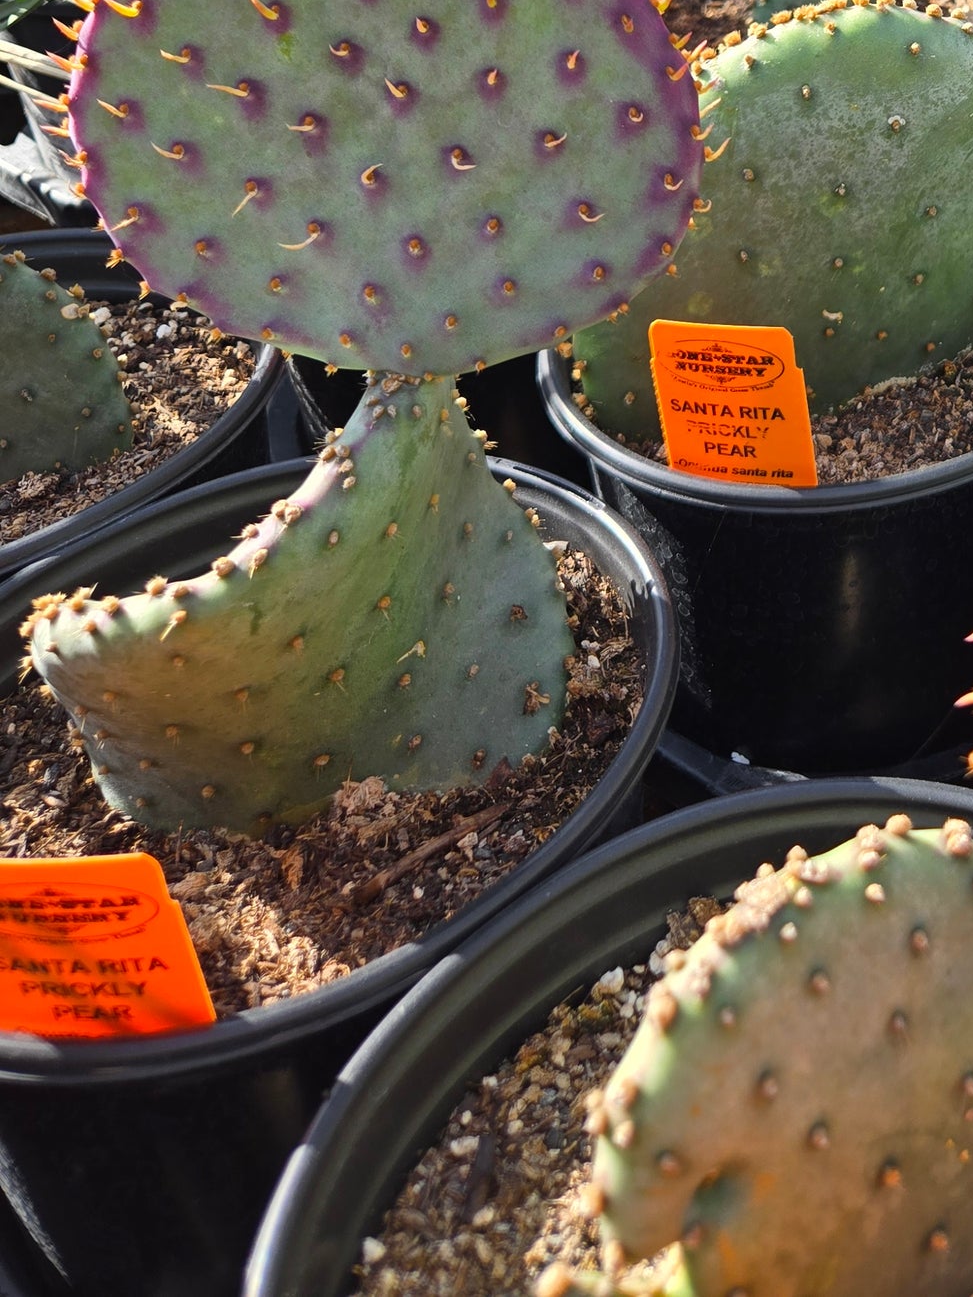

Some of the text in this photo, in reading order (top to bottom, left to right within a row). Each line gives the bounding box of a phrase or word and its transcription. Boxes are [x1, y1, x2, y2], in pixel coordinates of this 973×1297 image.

[720, 353, 775, 366] STAR
[674, 361, 767, 377] NURSERY
[670, 398, 786, 421] SANTA RITA
[704, 441, 758, 459] PEAR
[731, 466, 767, 477] santa
[771, 468, 794, 479] rita
[97, 956, 170, 974] RITA
[19, 980, 147, 998] PRICKLY
[51, 1004, 135, 1022] PEAR
